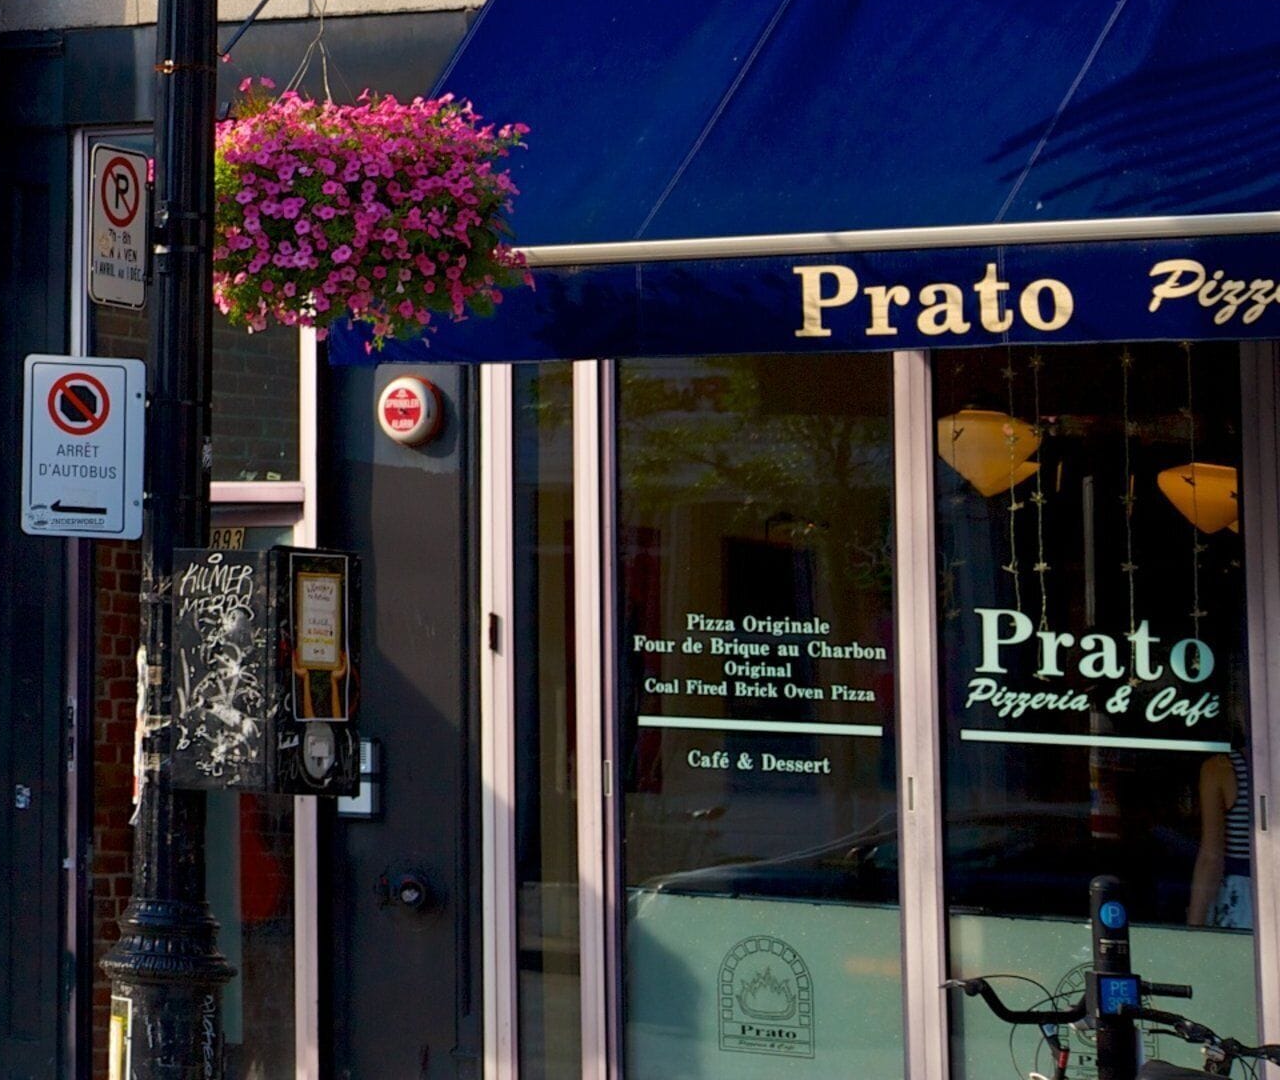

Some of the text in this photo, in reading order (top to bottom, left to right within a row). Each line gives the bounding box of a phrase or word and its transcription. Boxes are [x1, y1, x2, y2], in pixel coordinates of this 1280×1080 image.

[793, 263, 1074, 338] Prato
[56, 441, 100, 458] ARRÊT
[39, 463, 117, 480] D'AUTOBUS
[686, 613, 831, 636] Pizza Originale
[633, 635, 887, 660] Four de Brique au Charbon
[973, 607, 1215, 683] Prato
[724, 660, 792, 679] Original
[644, 677, 876, 702] Coal Fired Brick Oven Pizza
[965, 677, 1220, 727] Pizzeria & Café
[687, 749, 832, 774] Café & Dessert
[740, 1024, 798, 1040] Prato
